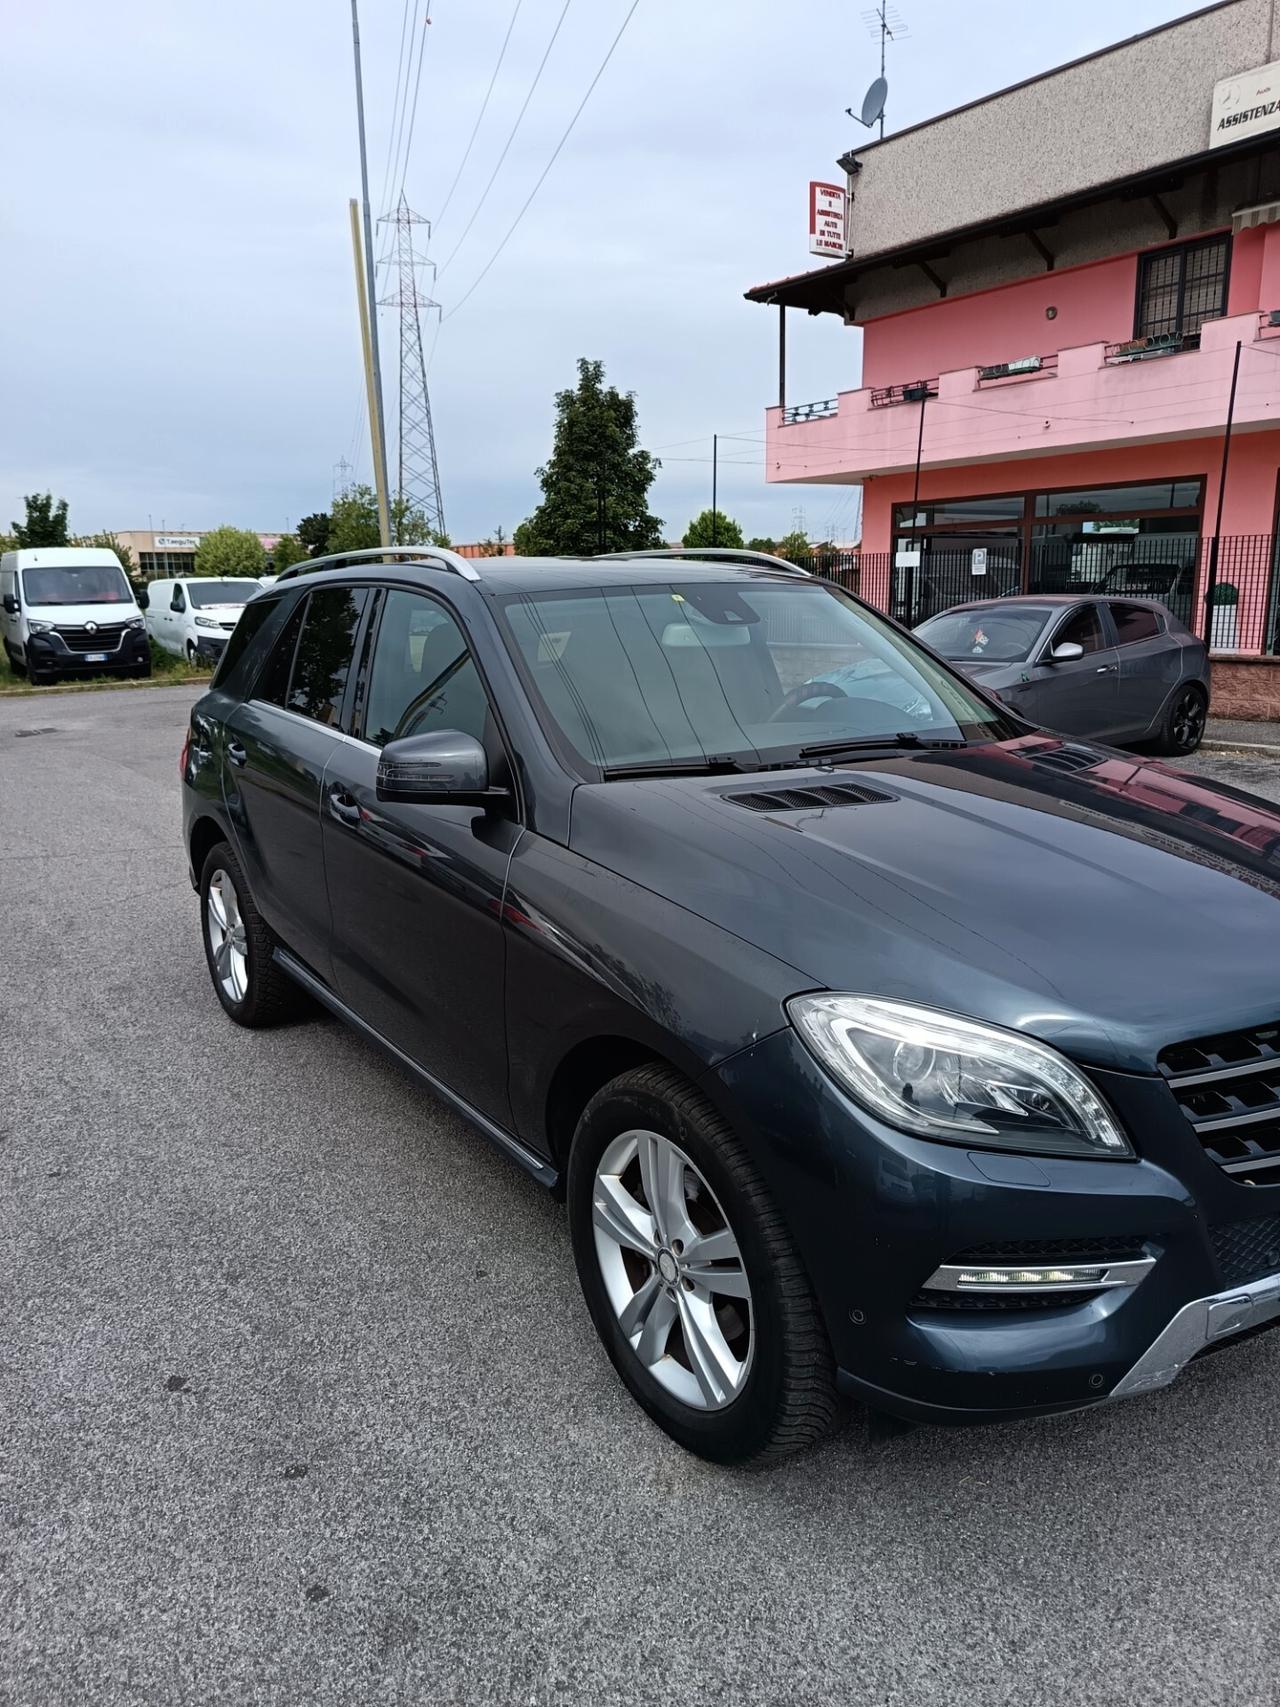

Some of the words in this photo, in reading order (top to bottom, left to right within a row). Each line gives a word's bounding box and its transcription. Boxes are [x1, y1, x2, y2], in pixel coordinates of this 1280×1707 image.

[1217, 100, 1280, 131] ASSISTENZA
[820, 189, 841, 200] VENDITA
[817, 209, 843, 220] ASSISTENZA
[827, 231, 841, 240] TUTTE
[824, 241, 843, 250] MARCHE
